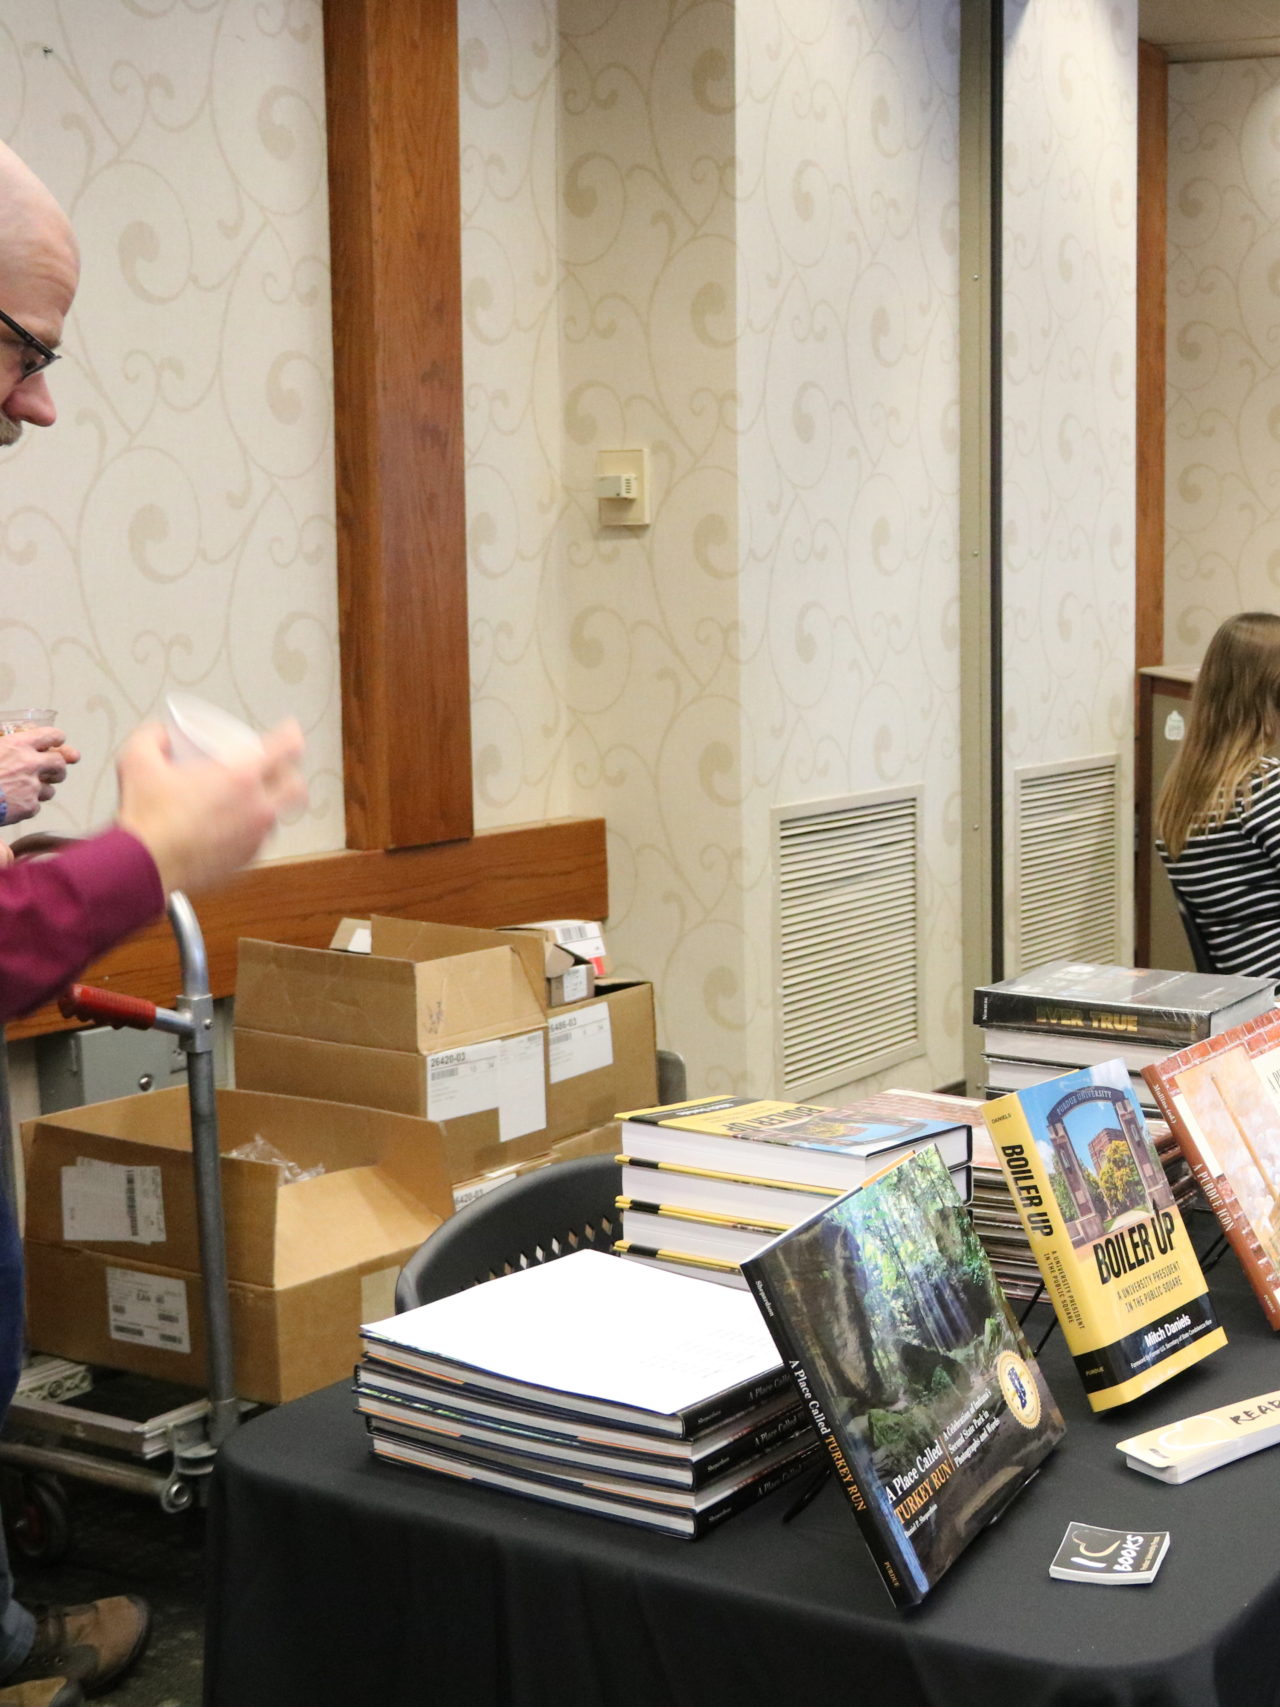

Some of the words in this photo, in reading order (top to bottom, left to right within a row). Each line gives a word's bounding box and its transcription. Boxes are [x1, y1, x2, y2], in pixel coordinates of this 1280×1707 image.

[550, 1017, 577, 1033] 6486-03
[1036, 1004, 1083, 1027] EVER
[1089, 1011, 1138, 1032] TRUE
[430, 1052, 466, 1068] 26420-03
[746, 1106, 825, 1126] BOILER
[991, 1113, 1011, 1124] DANIELS
[1056, 1096, 1077, 1115] PURDUE
[1077, 1089, 1112, 1101] UNIVERSITY
[1193, 1163, 1203, 1172] A
[456, 1189, 484, 1204] 6420-03
[1001, 1144, 1043, 1208] BOILER
[1027, 1212, 1053, 1236] UP
[1197, 1172, 1224, 1208] PURDUE
[1216, 1208, 1235, 1232] ICON
[1093, 1223, 1155, 1285] BOILER
[1150, 1211, 1175, 1255] UP
[1043, 1253, 1049, 1261] IN
[1053, 1275, 1065, 1298] PUBLIC
[1061, 1299, 1074, 1324] SQUARE
[1054, 1254, 1072, 1294] UNIVERSITY
[1069, 1295, 1085, 1329] PRESIDENT
[1117, 1291, 1122, 1300] A
[1121, 1276, 1153, 1299] UNIVERSITY
[1153, 1261, 1181, 1283] PRESIDENT
[1125, 1301, 1133, 1313] IN
[1133, 1296, 1144, 1309] THE
[1144, 1286, 1163, 1305] PUBLIC
[1162, 1275, 1183, 1293] SQUARE
[755, 1280, 774, 1317] Shepardson
[1144, 1327, 1166, 1347] Mitch
[1164, 1313, 1191, 1336] Daniels
[789, 1360, 800, 1369] A
[755, 1383, 773, 1398] Place
[794, 1370, 812, 1399] Place
[760, 1427, 778, 1443] Place
[778, 1415, 798, 1432] Called
[809, 1400, 831, 1435] Called
[946, 1411, 972, 1437] Celebration
[948, 1432, 965, 1454] Second
[962, 1424, 975, 1440] State
[973, 1414, 985, 1429] Park
[982, 1410, 990, 1420] in
[825, 1434, 853, 1483] TURKEY
[954, 1438, 981, 1468] Photographs
[980, 1427, 989, 1442] and
[985, 1416, 1000, 1433] Words
[885, 1486, 897, 1503] A
[892, 1468, 919, 1496] Place
[916, 1440, 943, 1472] Called
[848, 1484, 867, 1511] RUN
[894, 1478, 935, 1524] TURKEY
[931, 1461, 952, 1489] RUN
[1070, 1557, 1107, 1568] I
[1113, 1534, 1144, 1571] BOOKS
